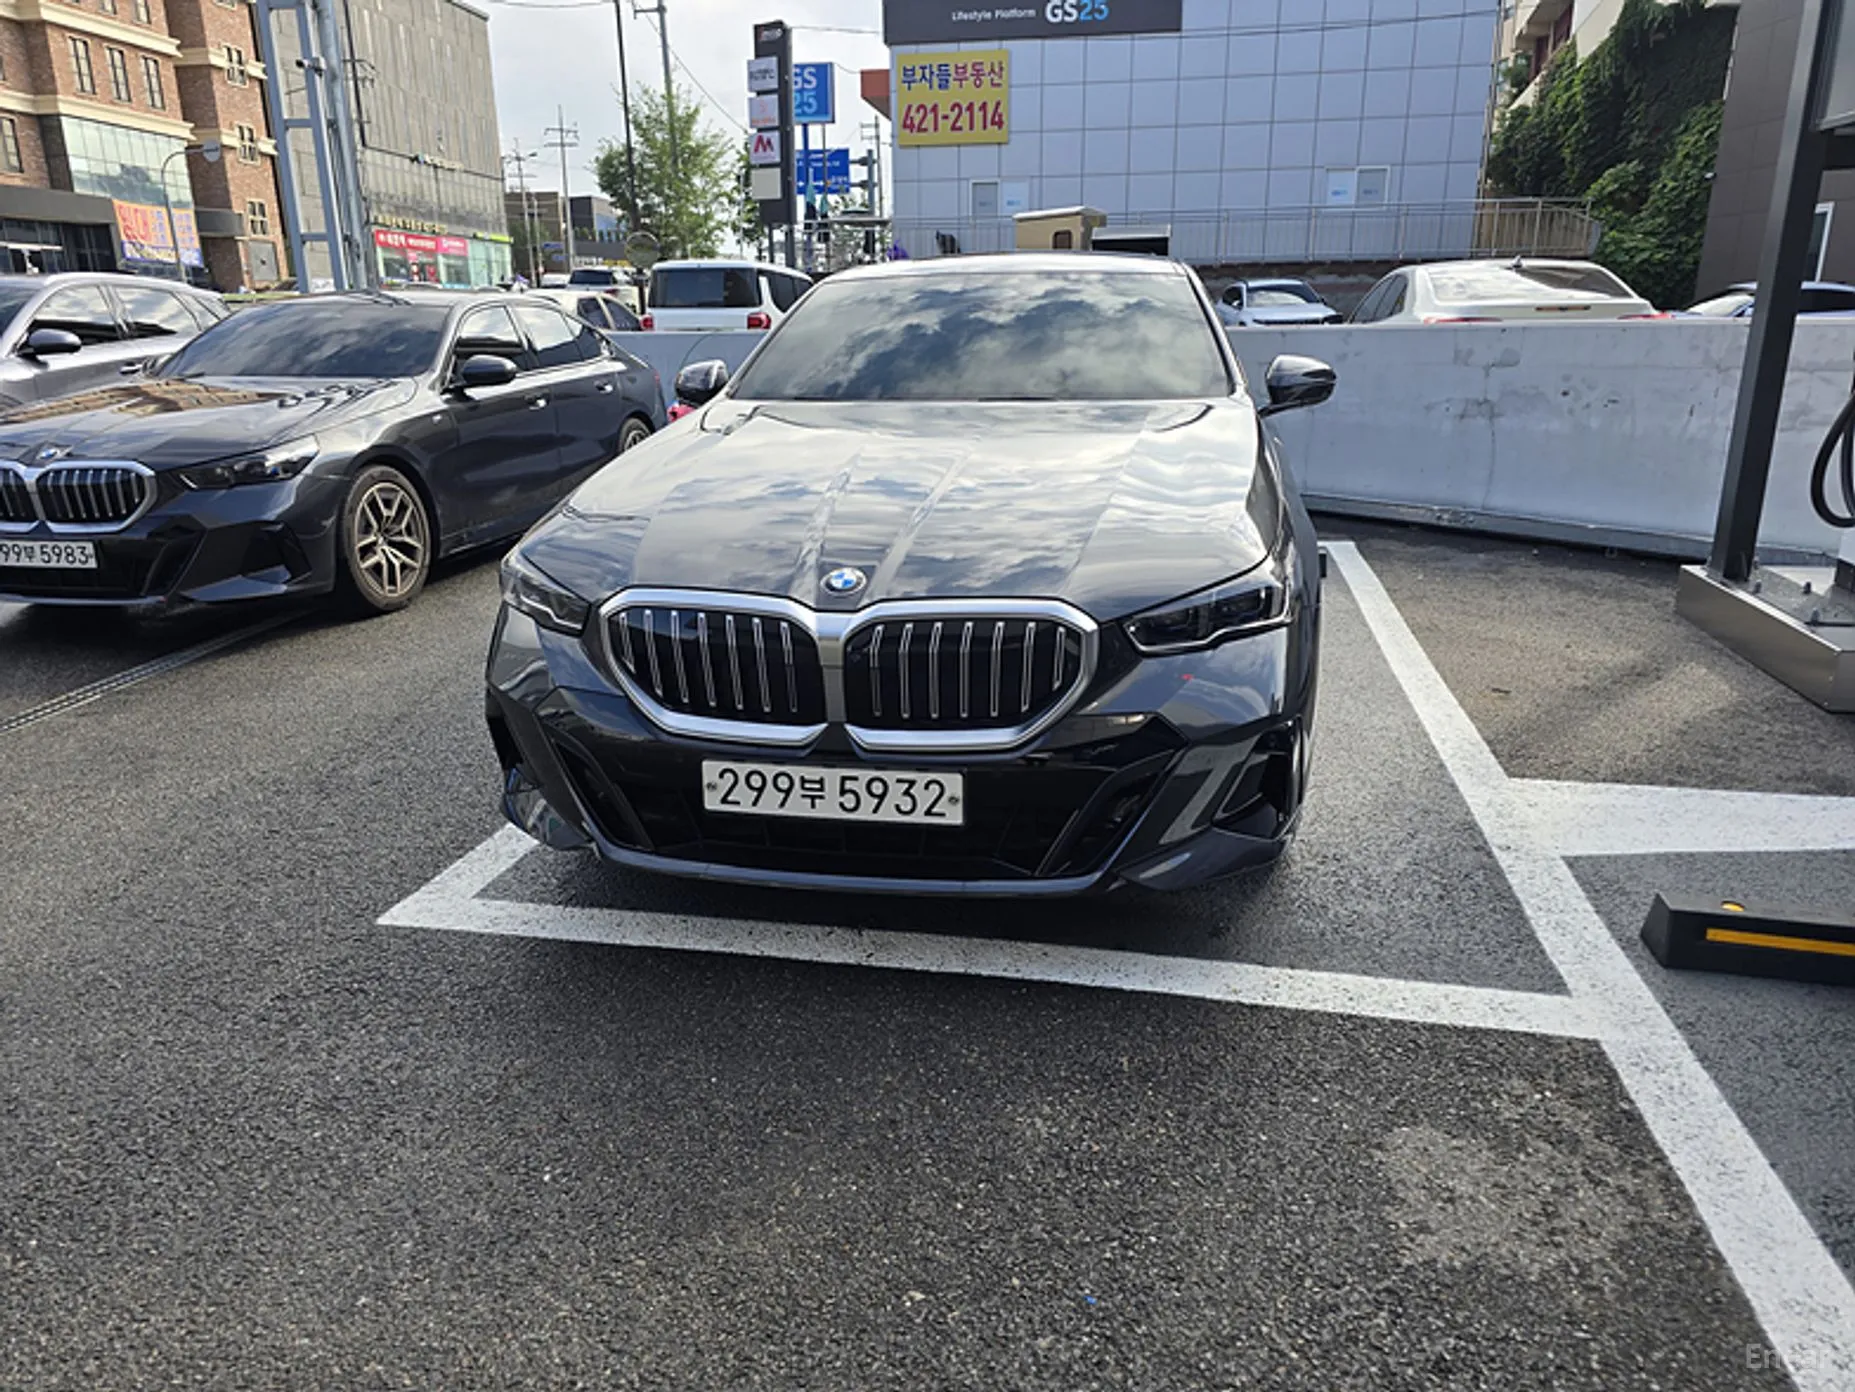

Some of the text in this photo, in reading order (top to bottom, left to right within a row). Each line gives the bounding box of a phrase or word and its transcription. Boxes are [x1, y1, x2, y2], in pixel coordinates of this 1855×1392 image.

[952, 0, 1109, 23] Lifestyle Platform GS25
[901, 61, 1004, 91] 부자들부동산
[902, 100, 1004, 133] 421-2114
[40, 544, 89, 565] 5983
[718, 767, 947, 818] 299부 5932
